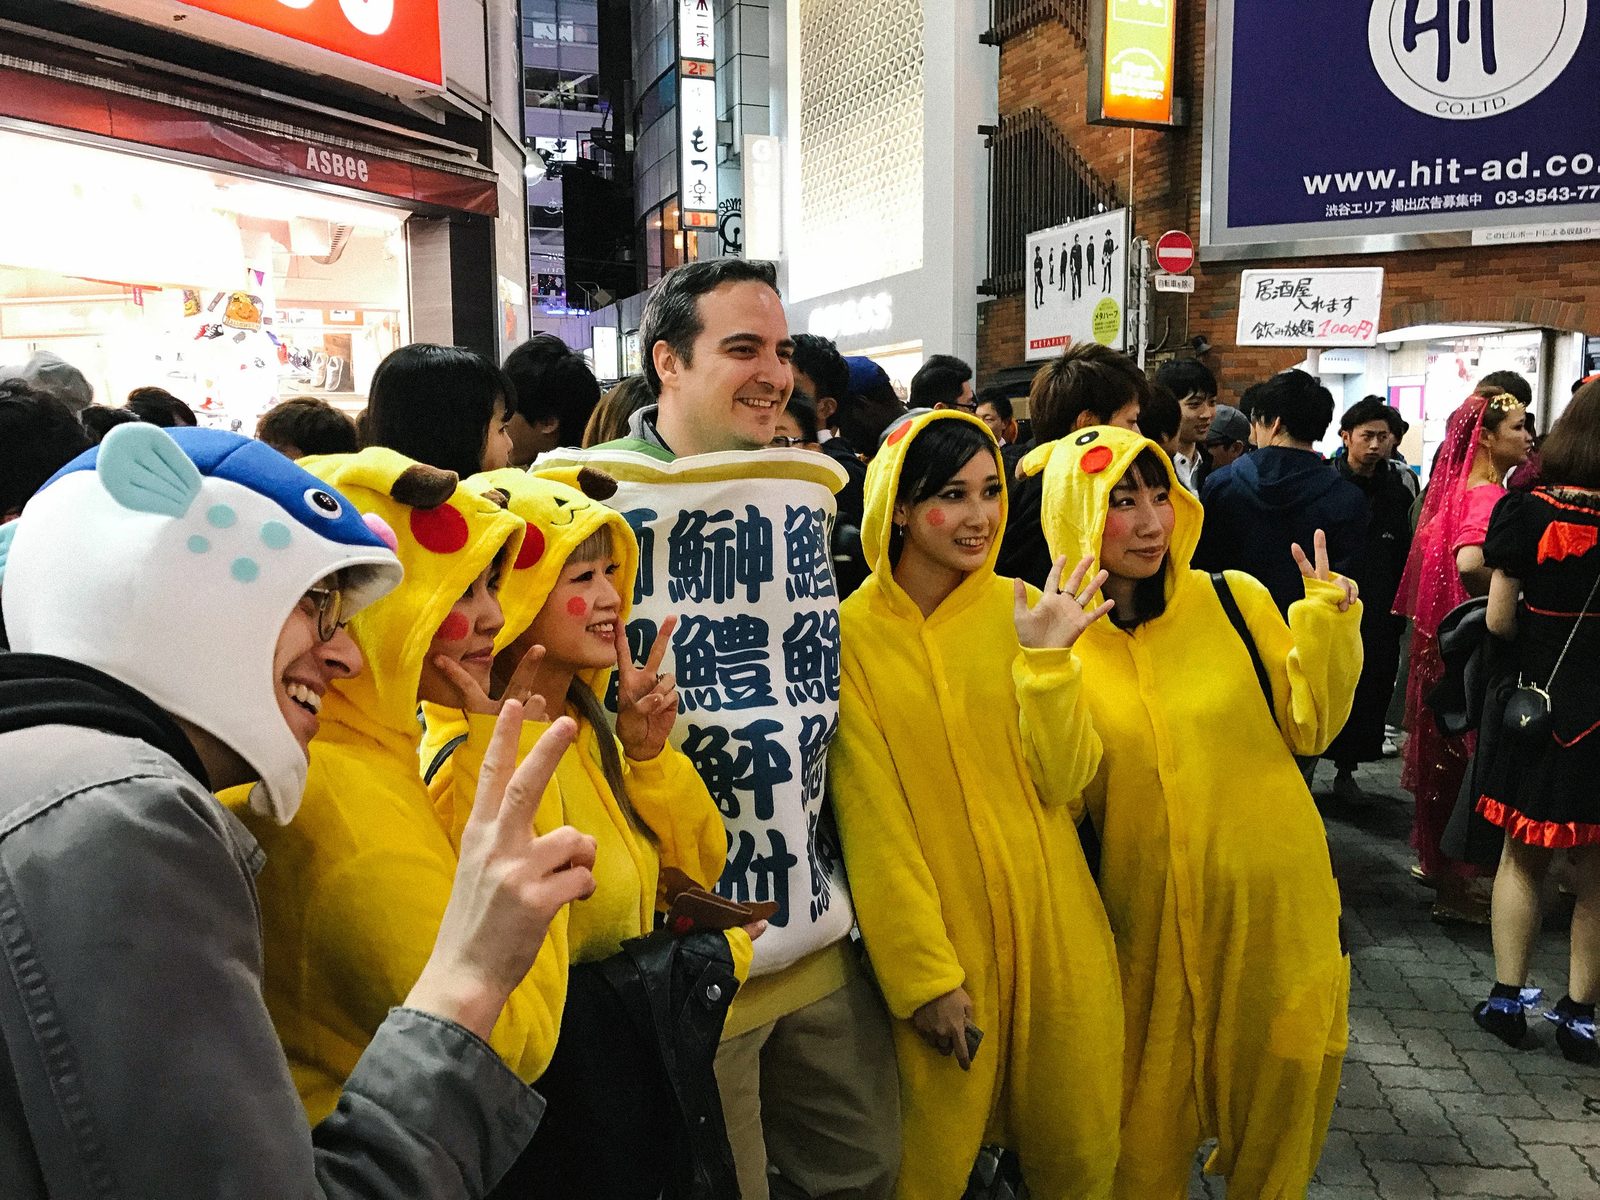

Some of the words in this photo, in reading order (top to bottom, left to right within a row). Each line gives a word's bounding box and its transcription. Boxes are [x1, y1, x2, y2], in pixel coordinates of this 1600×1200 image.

[688, 62, 706, 75] 2F
[306, 147, 369, 183] ASBee
[1494, 185, 1600, 205] 03-3543-77
[1255, 277, 1313, 301] 居酒屋
[1293, 296, 1359, 317] 入れます
[1251, 319, 1315, 340] 飲み放題
[1317, 319, 1373, 340] 1000円
